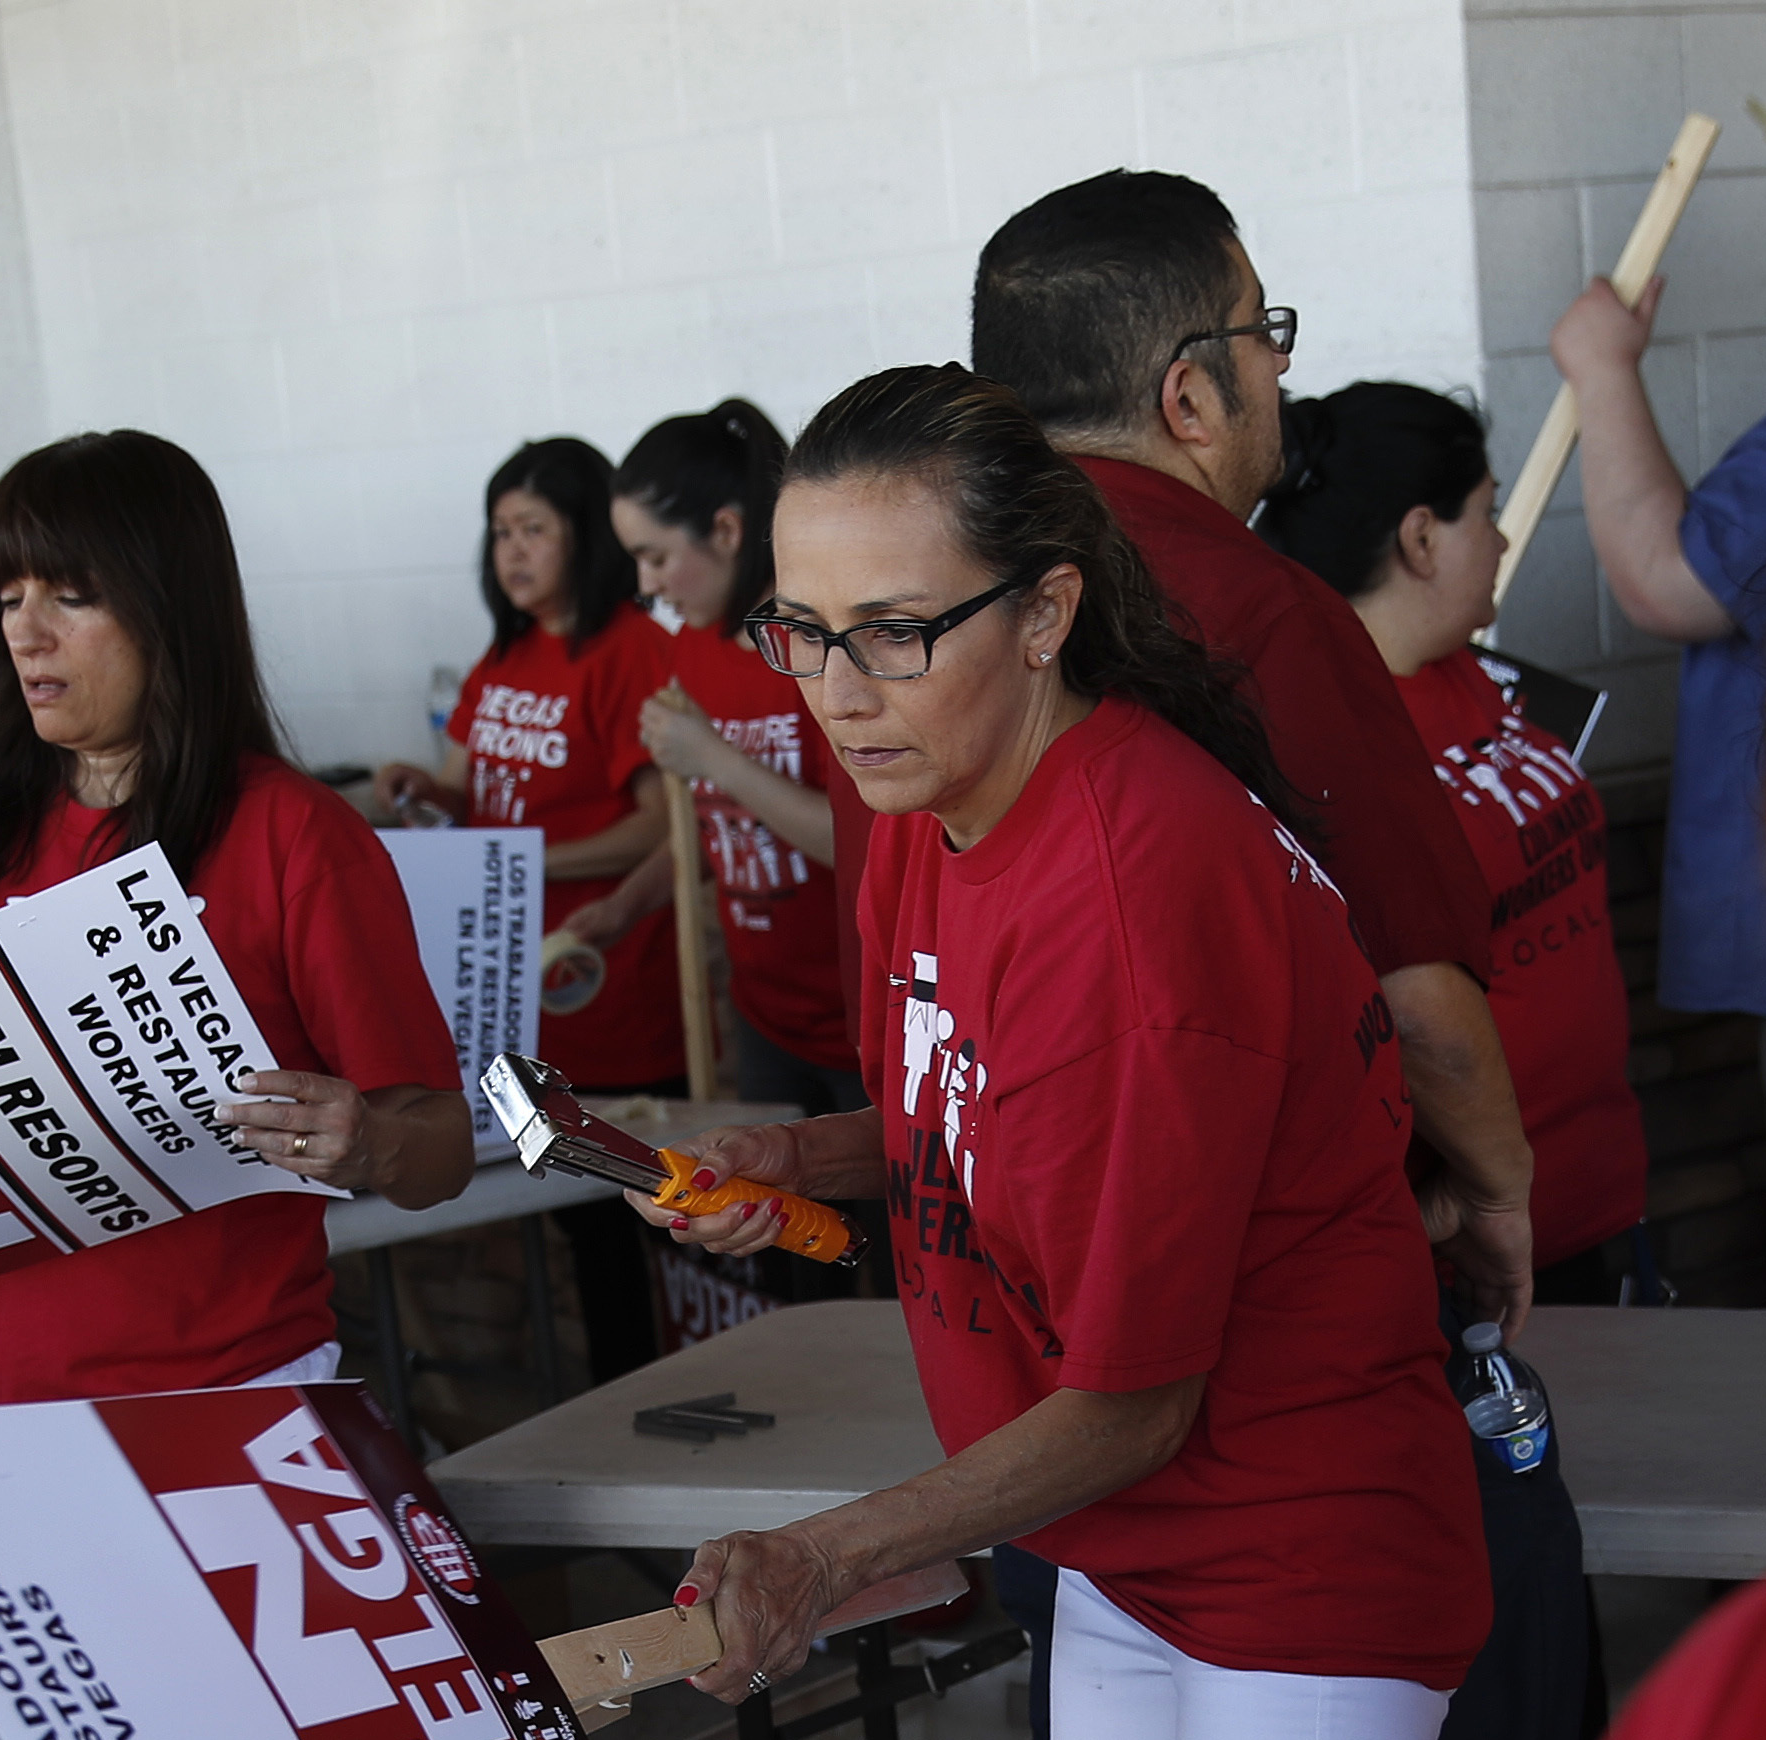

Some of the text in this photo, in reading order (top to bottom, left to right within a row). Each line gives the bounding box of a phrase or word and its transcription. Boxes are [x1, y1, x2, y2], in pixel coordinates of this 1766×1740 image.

[1517, 788, 1597, 867] CULINARY
[484, 841, 503, 940] HOTELES
[509, 854, 526, 900] LOS
[1491, 845, 1580, 930] WORKERS
[86, 926, 122, 957] &
[458, 907, 476, 938] EN
[483, 945, 500, 961] Y
[1489, 904, 1601, 976] LOCAL
[116, 870, 256, 1094] LAS VEGAS
[457, 946, 475, 989] LAS
[67, 993, 196, 1155] WORKERS
